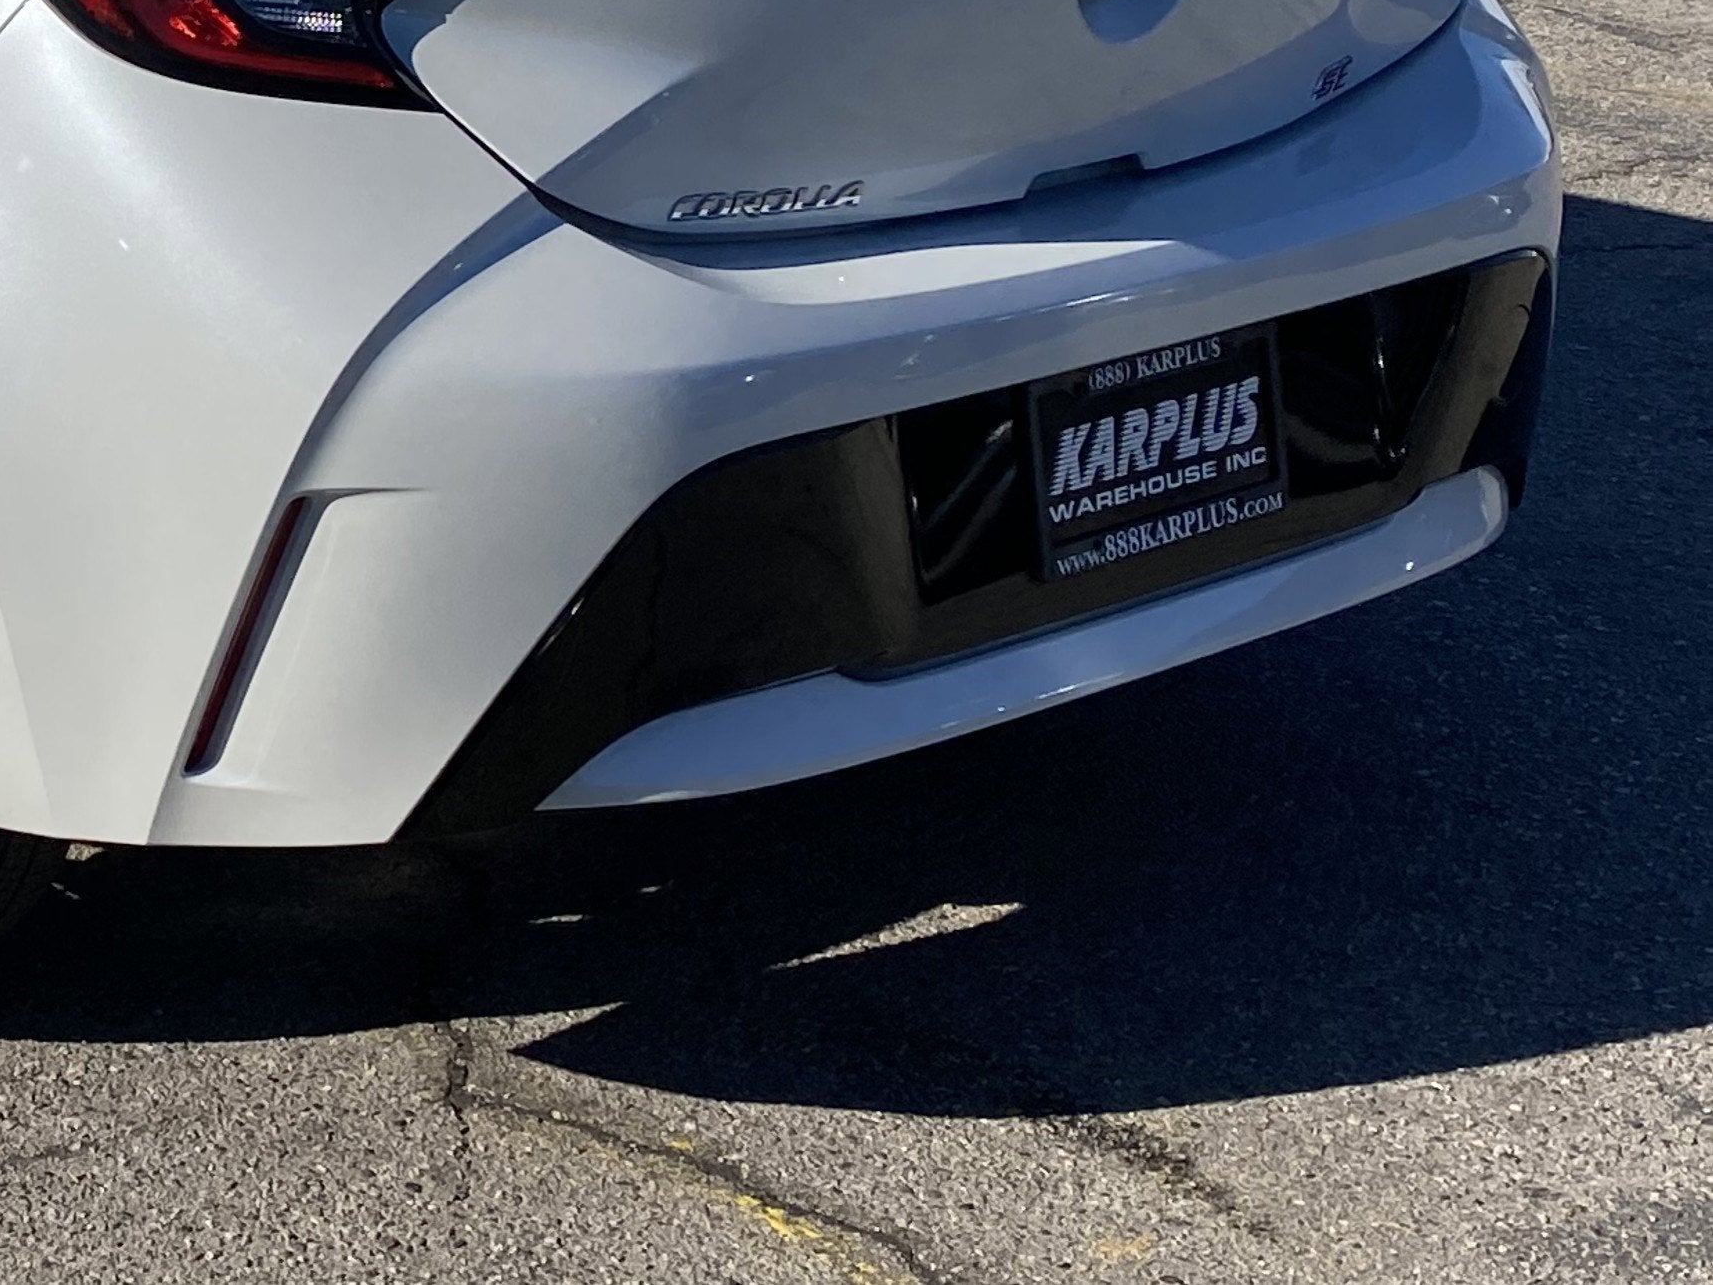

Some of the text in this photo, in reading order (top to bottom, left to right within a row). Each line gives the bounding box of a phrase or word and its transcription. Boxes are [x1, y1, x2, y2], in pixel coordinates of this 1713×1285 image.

[667, 179, 864, 222] COROLLA
[1087, 336, 1221, 391] (888) KARPLUS
[1047, 375, 1260, 496] KARPLUS
[1048, 446, 1268, 523] WAREHOUSE INC
